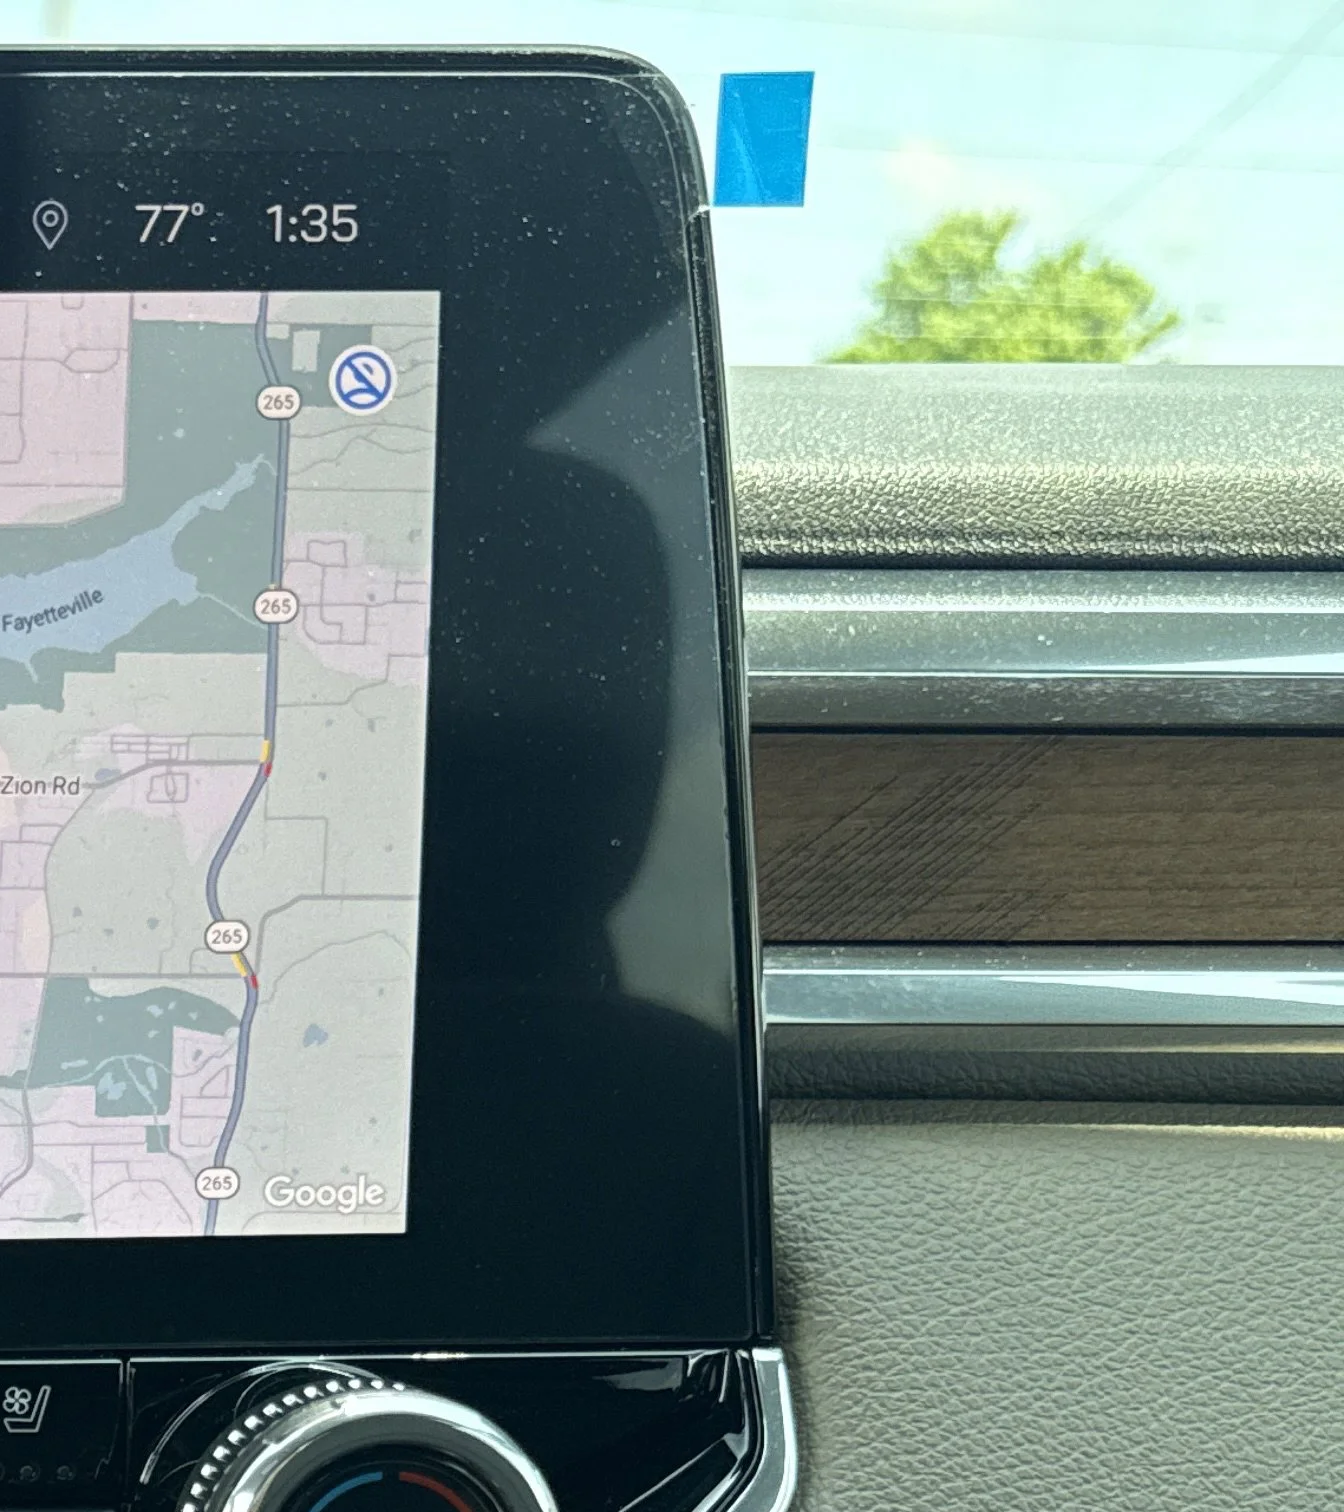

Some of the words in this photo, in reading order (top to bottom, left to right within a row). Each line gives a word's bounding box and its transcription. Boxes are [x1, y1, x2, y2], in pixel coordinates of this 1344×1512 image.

[136, 203, 205, 243] 77°
[266, 205, 359, 242] 1:35
[262, 395, 295, 410] 265
[2, 587, 104, 632] Fayetteville
[260, 598, 293, 614] 265
[0, 775, 45, 795] Zion
[52, 776, 80, 796] Rd
[211, 928, 243, 943] 265
[202, 1176, 233, 1191] 265
[264, 1176, 385, 1214] Google
